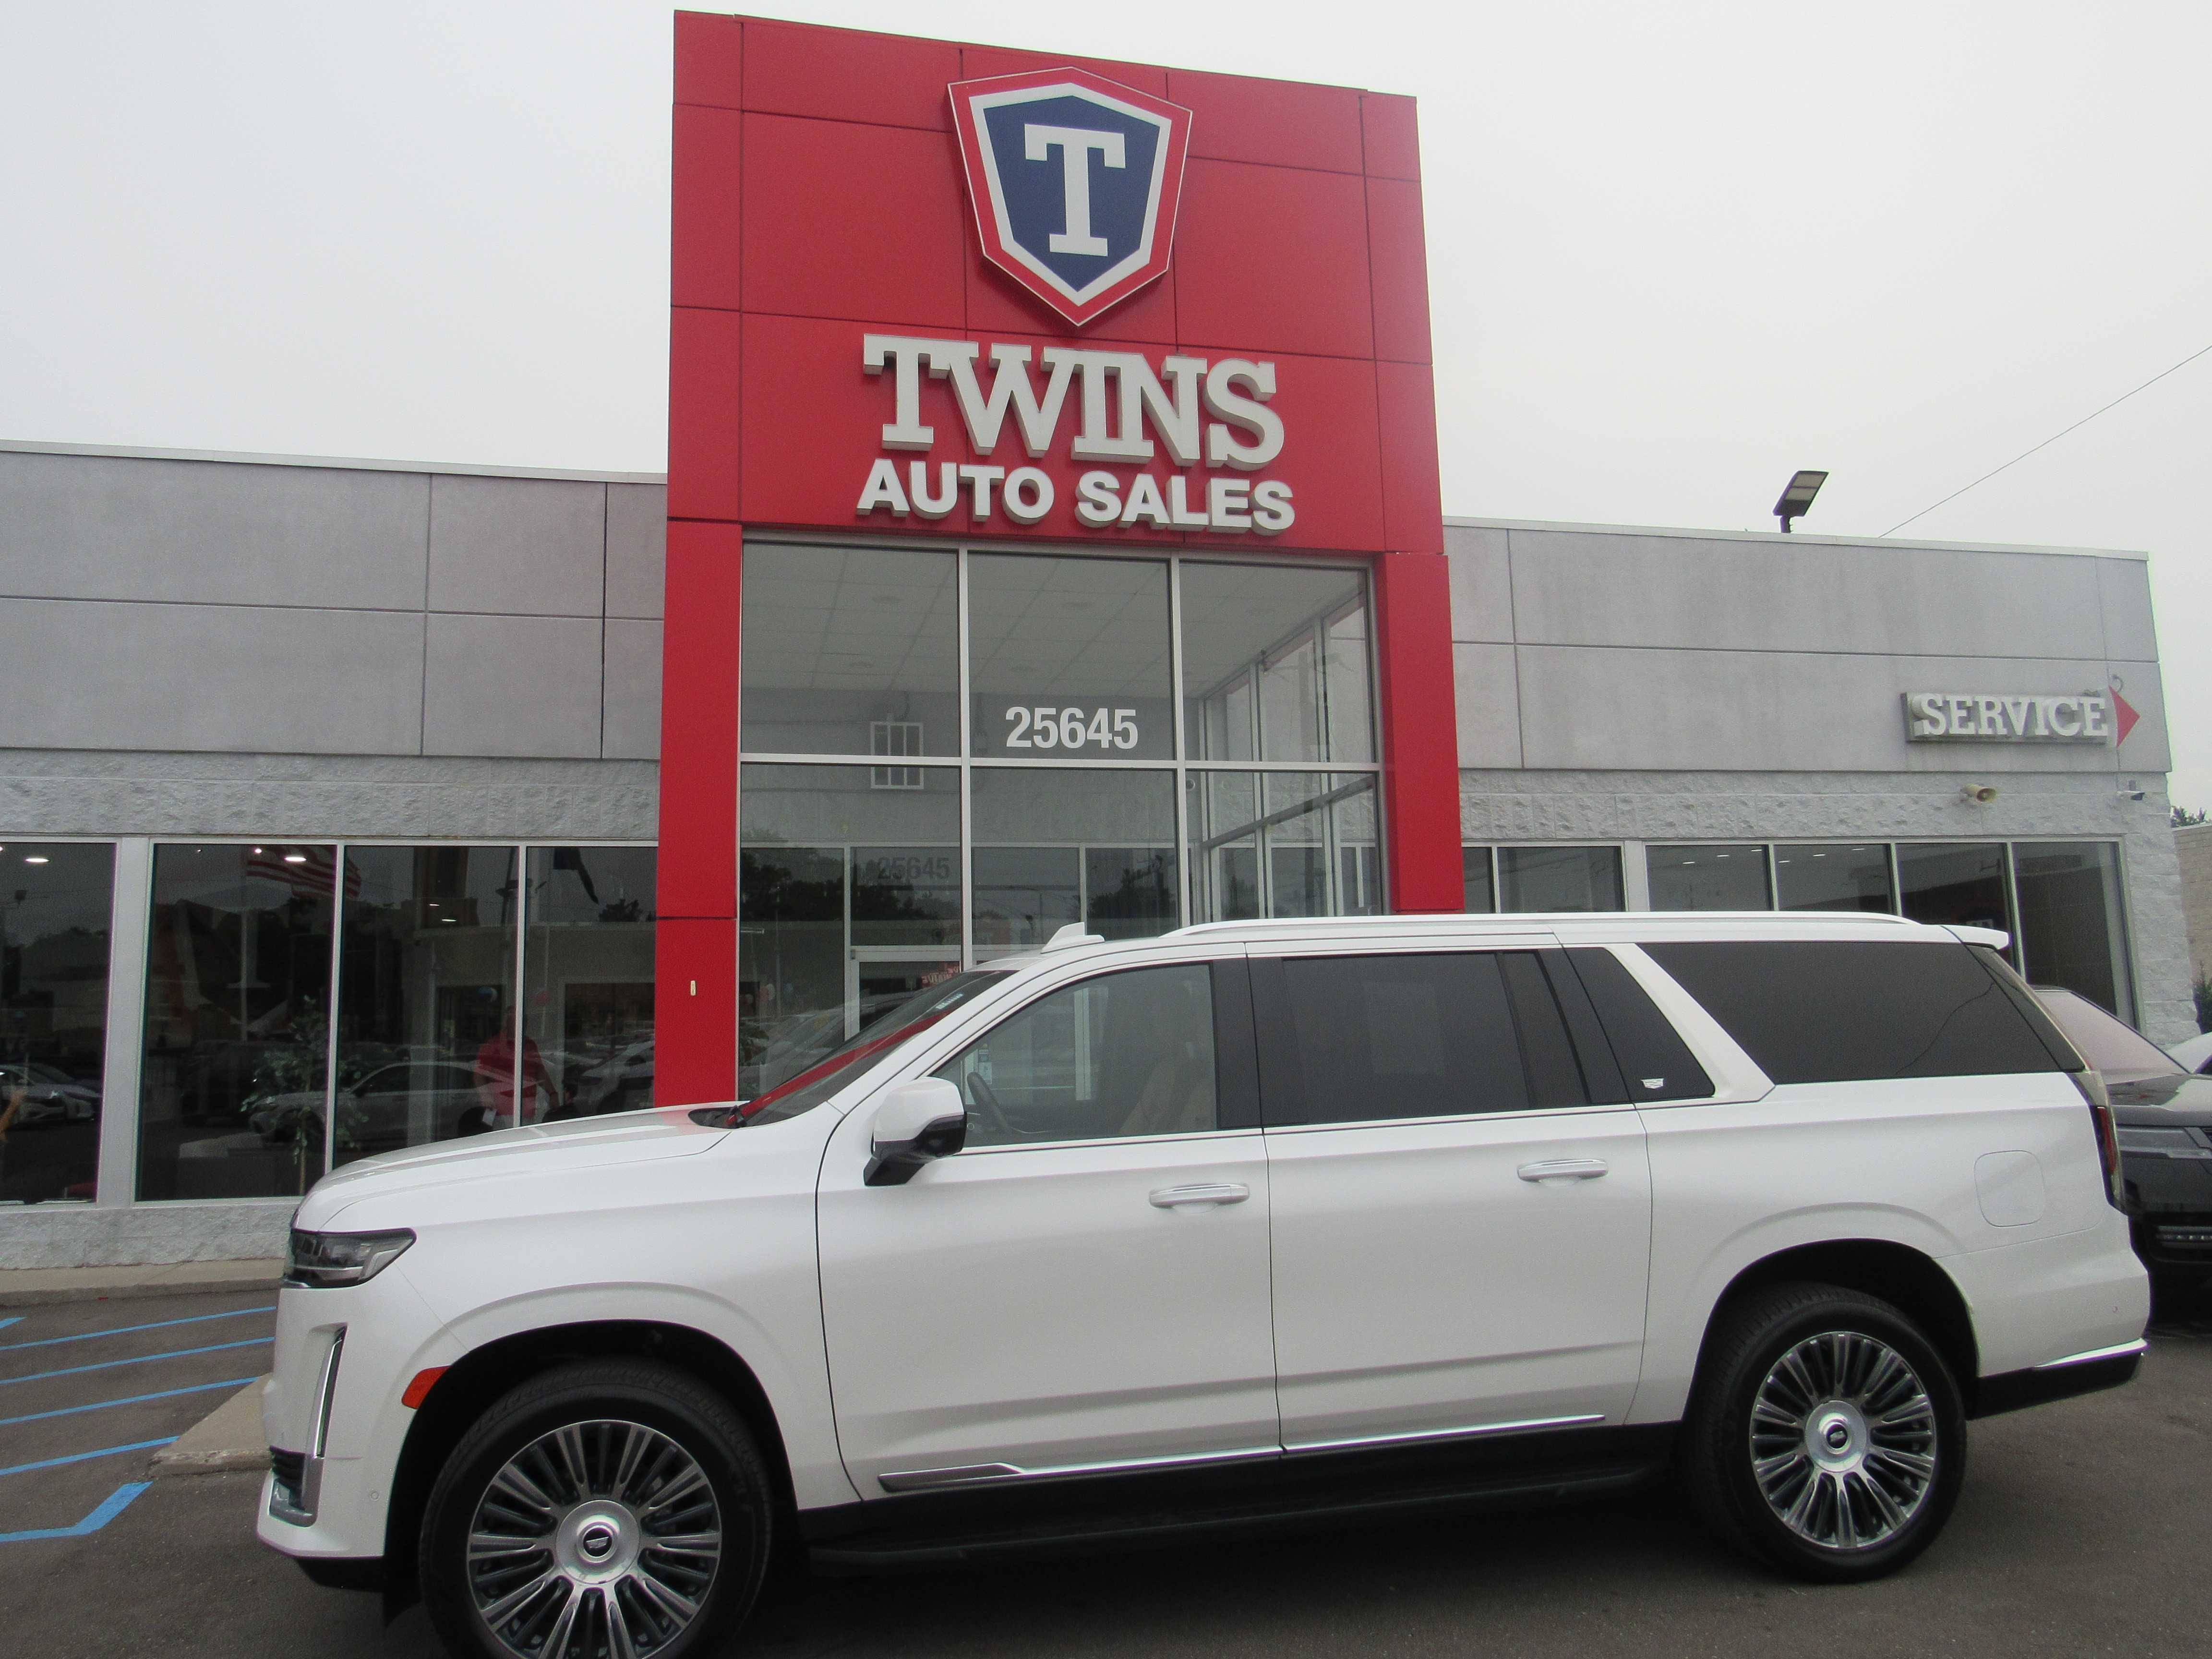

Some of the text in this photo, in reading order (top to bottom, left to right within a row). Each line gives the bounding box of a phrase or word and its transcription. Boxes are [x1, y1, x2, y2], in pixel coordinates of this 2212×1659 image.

[1024, 124, 1126, 257] T
[864, 334, 1285, 471] TWINS
[856, 458, 1295, 536] AUTO SALES
[1006, 706, 1138, 749] 25645
[1912, 693, 2108, 736] SERVICE
